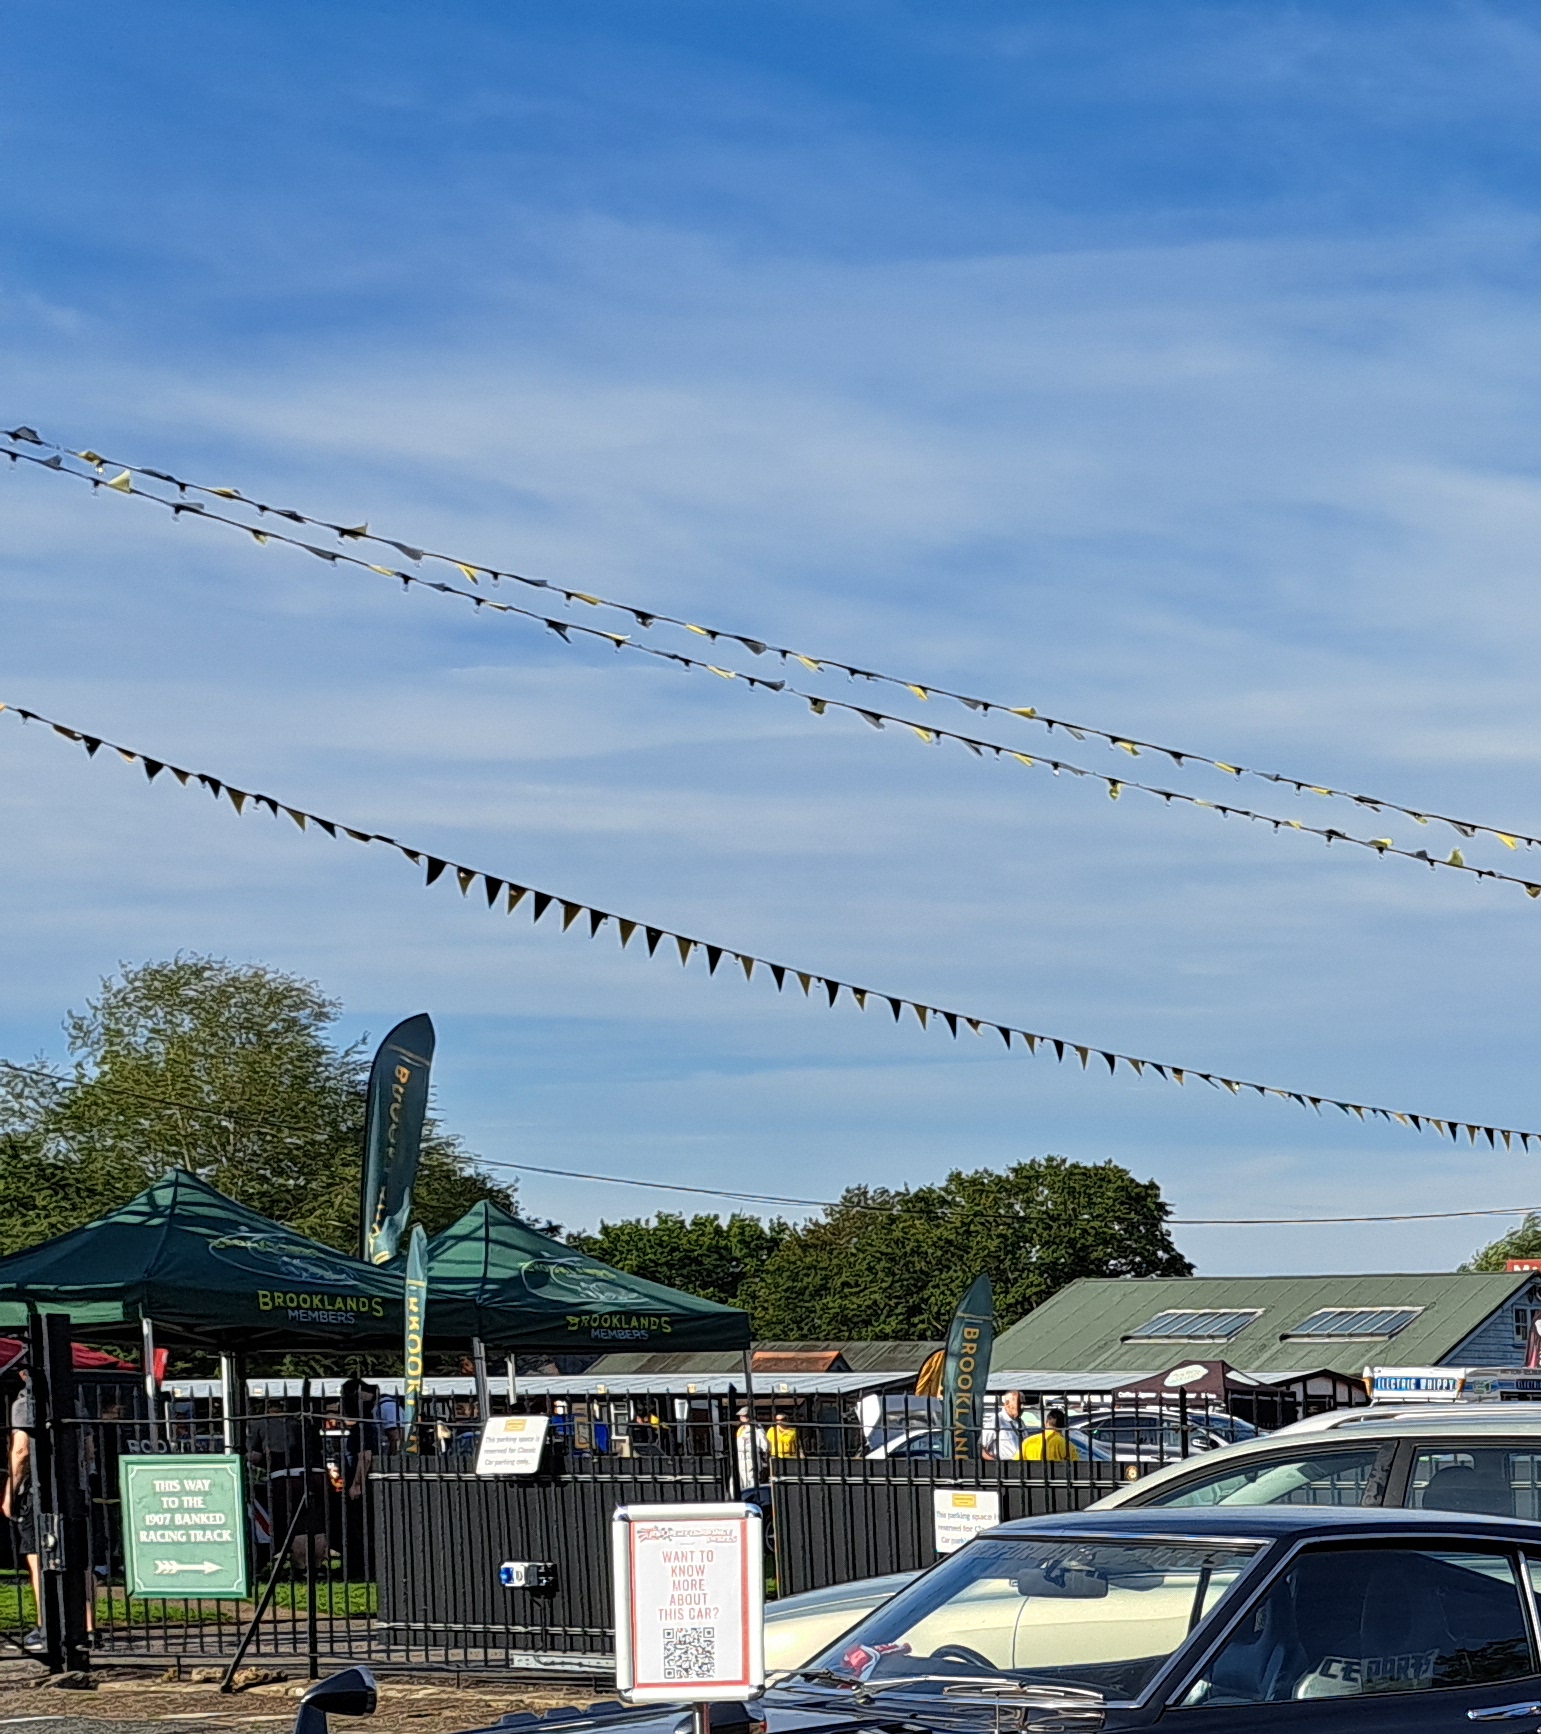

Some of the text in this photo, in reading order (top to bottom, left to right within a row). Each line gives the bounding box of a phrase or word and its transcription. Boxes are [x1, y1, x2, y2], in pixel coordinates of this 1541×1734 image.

[257, 1290, 384, 1317] BROOKLANDS
[288, 1308, 356, 1325] MEMBERS
[566, 1315, 672, 1333] BROOKLANDS
[591, 1329, 649, 1341] MEMBERS
[1377, 1377, 1455, 1391] ELECTRIC WHIPPY
[153, 1479, 211, 1492] THIS WAY
[161, 1497, 206, 1509] TO THE
[145, 1513, 225, 1526] 1907 BANKED
[139, 1530, 234, 1542] RACING TRACK
[662, 1550, 714, 1563] WANT TO
[671, 1565, 706, 1578] KNOW
[672, 1579, 705, 1592] MORE
[669, 1593, 708, 1606] ABOUT
[659, 1607, 719, 1621] THIS CAR?
